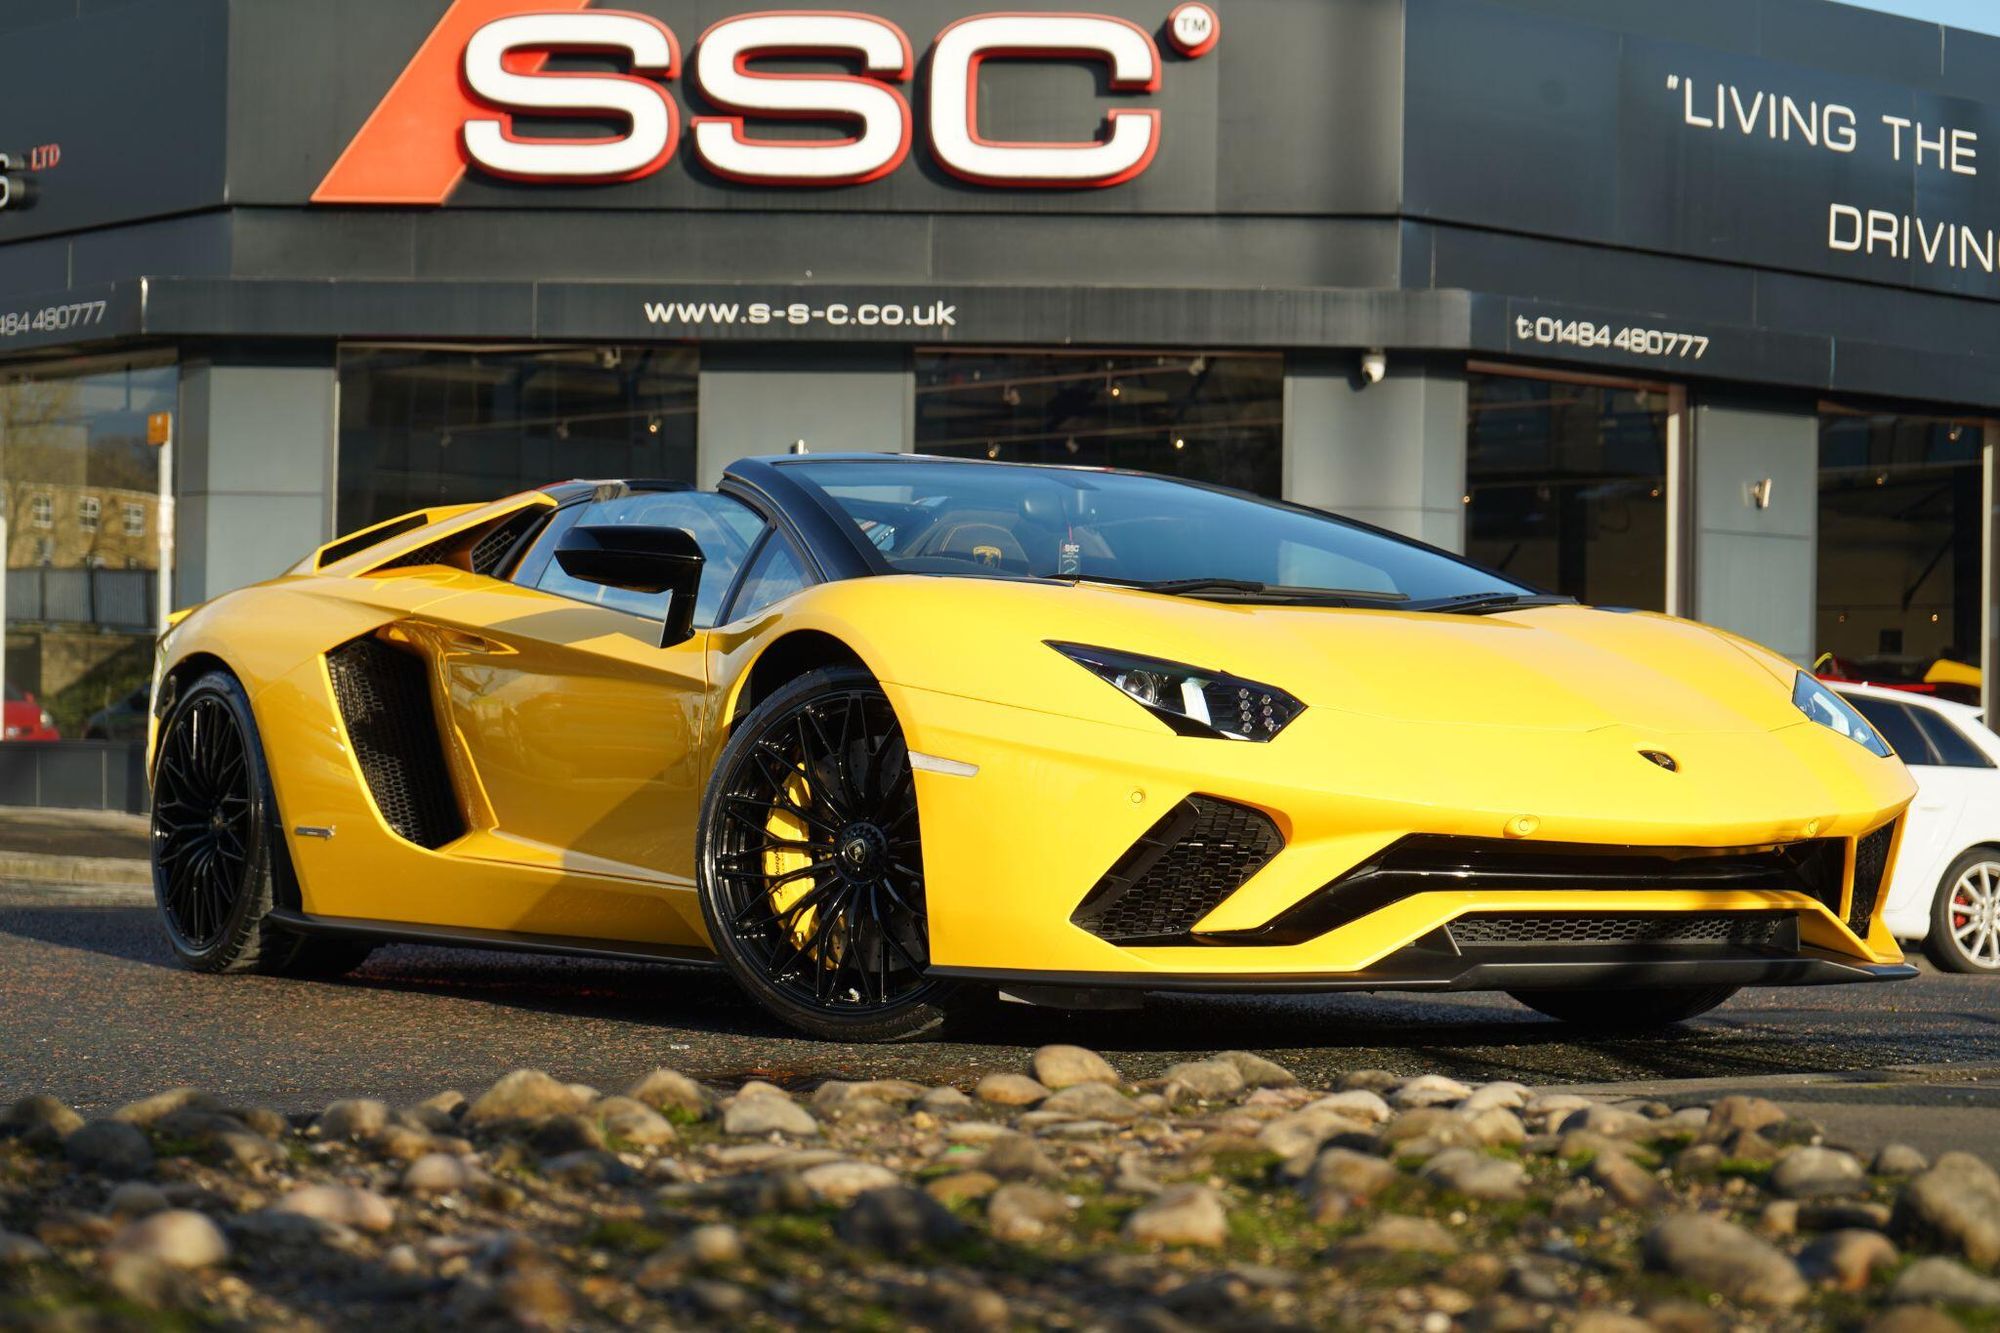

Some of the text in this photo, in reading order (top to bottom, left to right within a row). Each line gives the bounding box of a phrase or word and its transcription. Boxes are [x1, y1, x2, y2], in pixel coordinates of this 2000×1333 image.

[1180, 16, 1206, 32] TM
[459, 9, 1162, 187] SSC
[31, 143, 61, 172] LTD
[1881, 114, 1978, 176] THE
[1828, 202, 2000, 273] DRIVIN
[32, 300, 107, 332] 480777
[643, 300, 957, 326] www.s-s-c.co.uk
[1613, 326, 1709, 360] 480777
